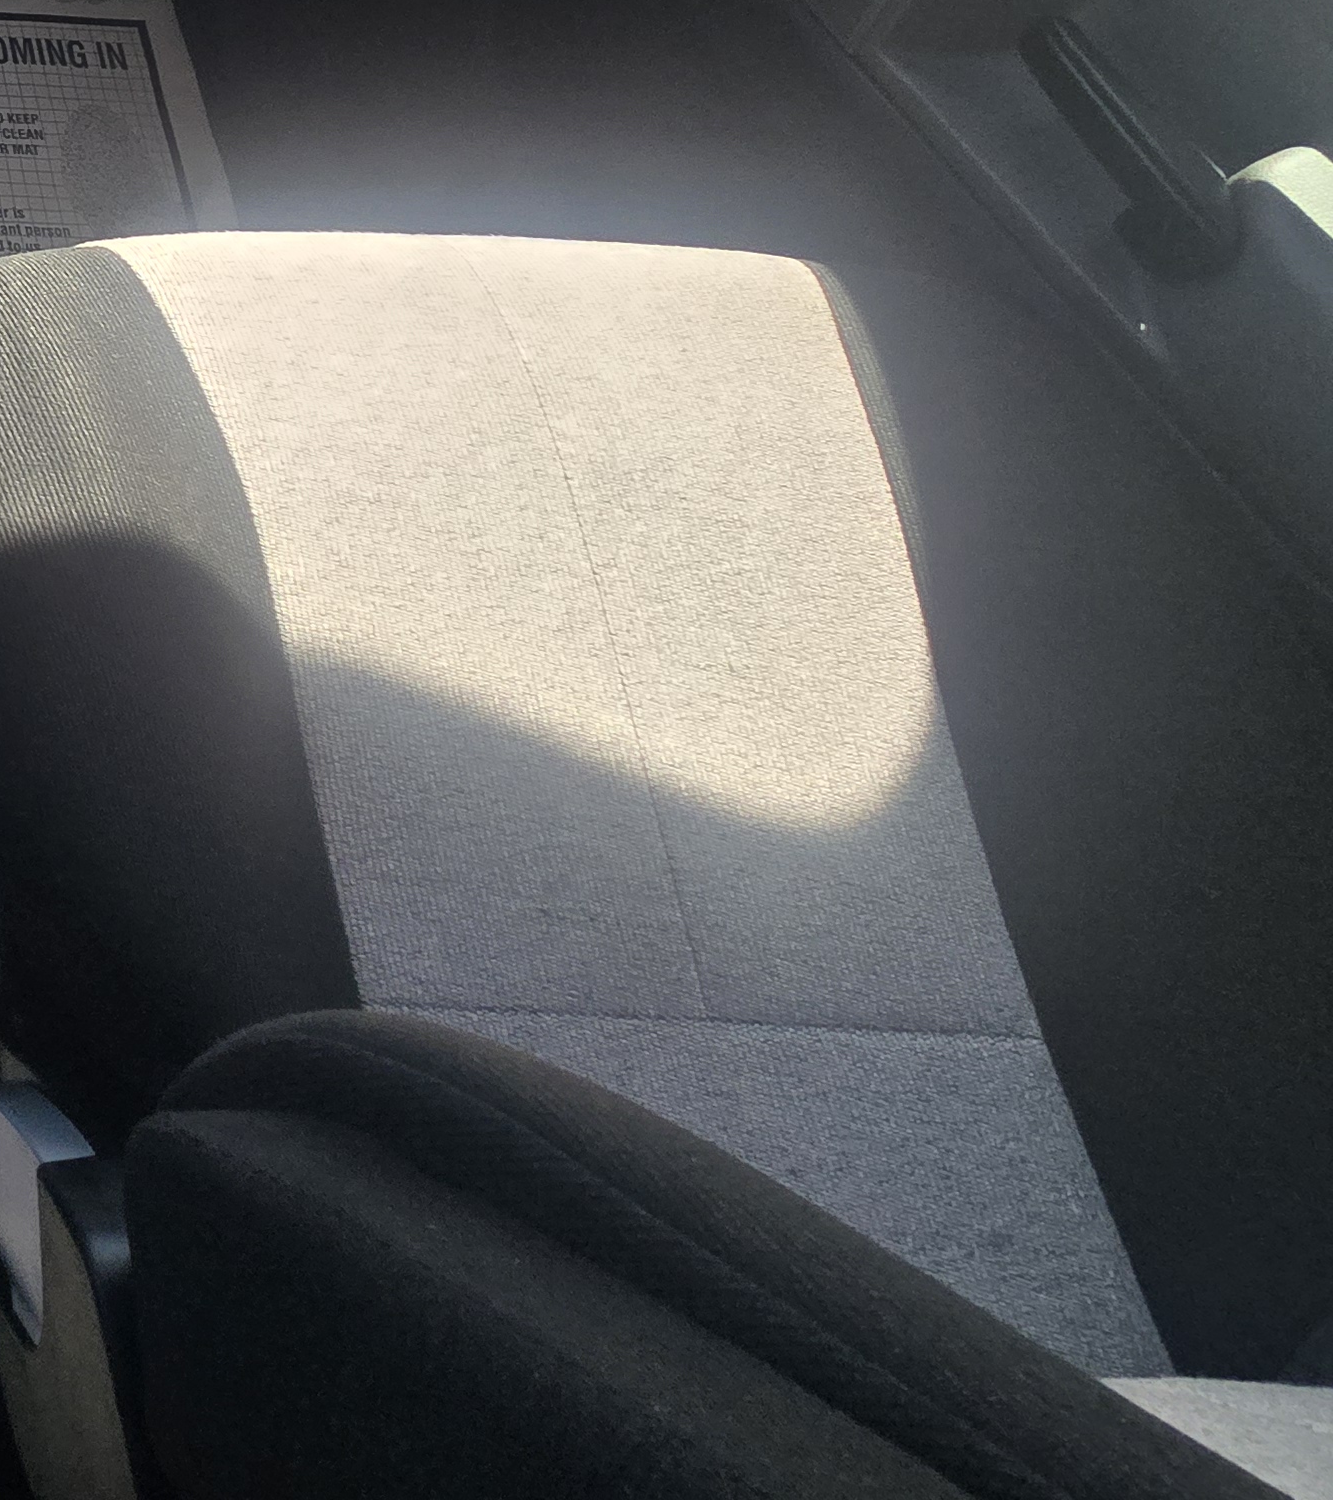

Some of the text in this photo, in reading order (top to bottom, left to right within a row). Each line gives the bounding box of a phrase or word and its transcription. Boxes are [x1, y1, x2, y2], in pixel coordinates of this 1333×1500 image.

[96, 40, 130, 71] IN
[6, 112, 39, 125] KEEP
[2, 127, 44, 141] CLEAN
[12, 143, 39, 156] MAT
[12, 208, 25, 220] is
[24, 225, 71, 240] person
[6, 240, 20, 254] to
